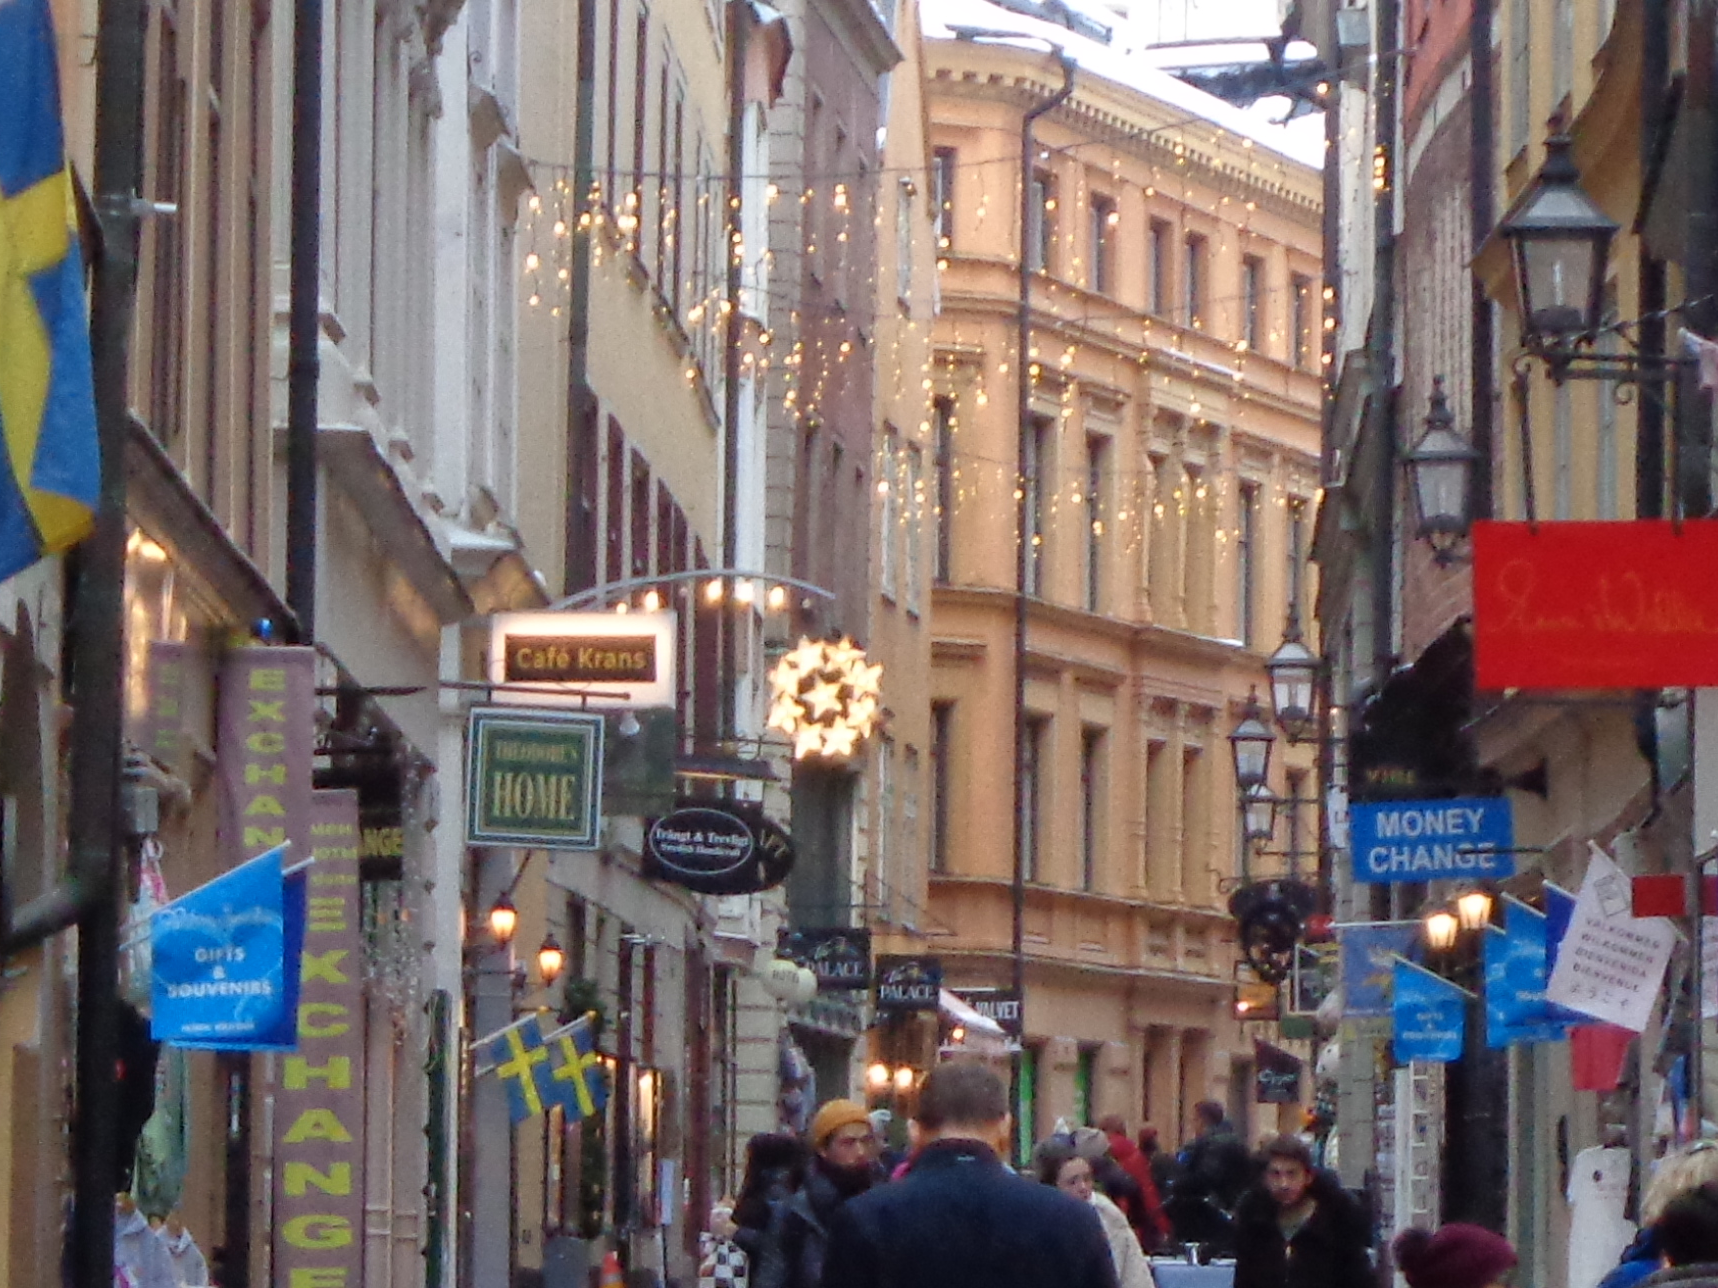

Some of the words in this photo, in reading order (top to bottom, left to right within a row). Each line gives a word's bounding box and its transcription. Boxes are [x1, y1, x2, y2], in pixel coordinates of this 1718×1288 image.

[516, 646, 570, 669] Café
[578, 647, 647, 669] Krans
[243, 668, 287, 848] EXCHAN
[493, 771, 576, 819] HOME
[1376, 808, 1485, 839] MONEY
[1368, 842, 1496, 873] CHANGE
[194, 944, 246, 962] GIFTS
[167, 980, 272, 999] SOUVENIRS
[879, 984, 934, 1000] PALACE
